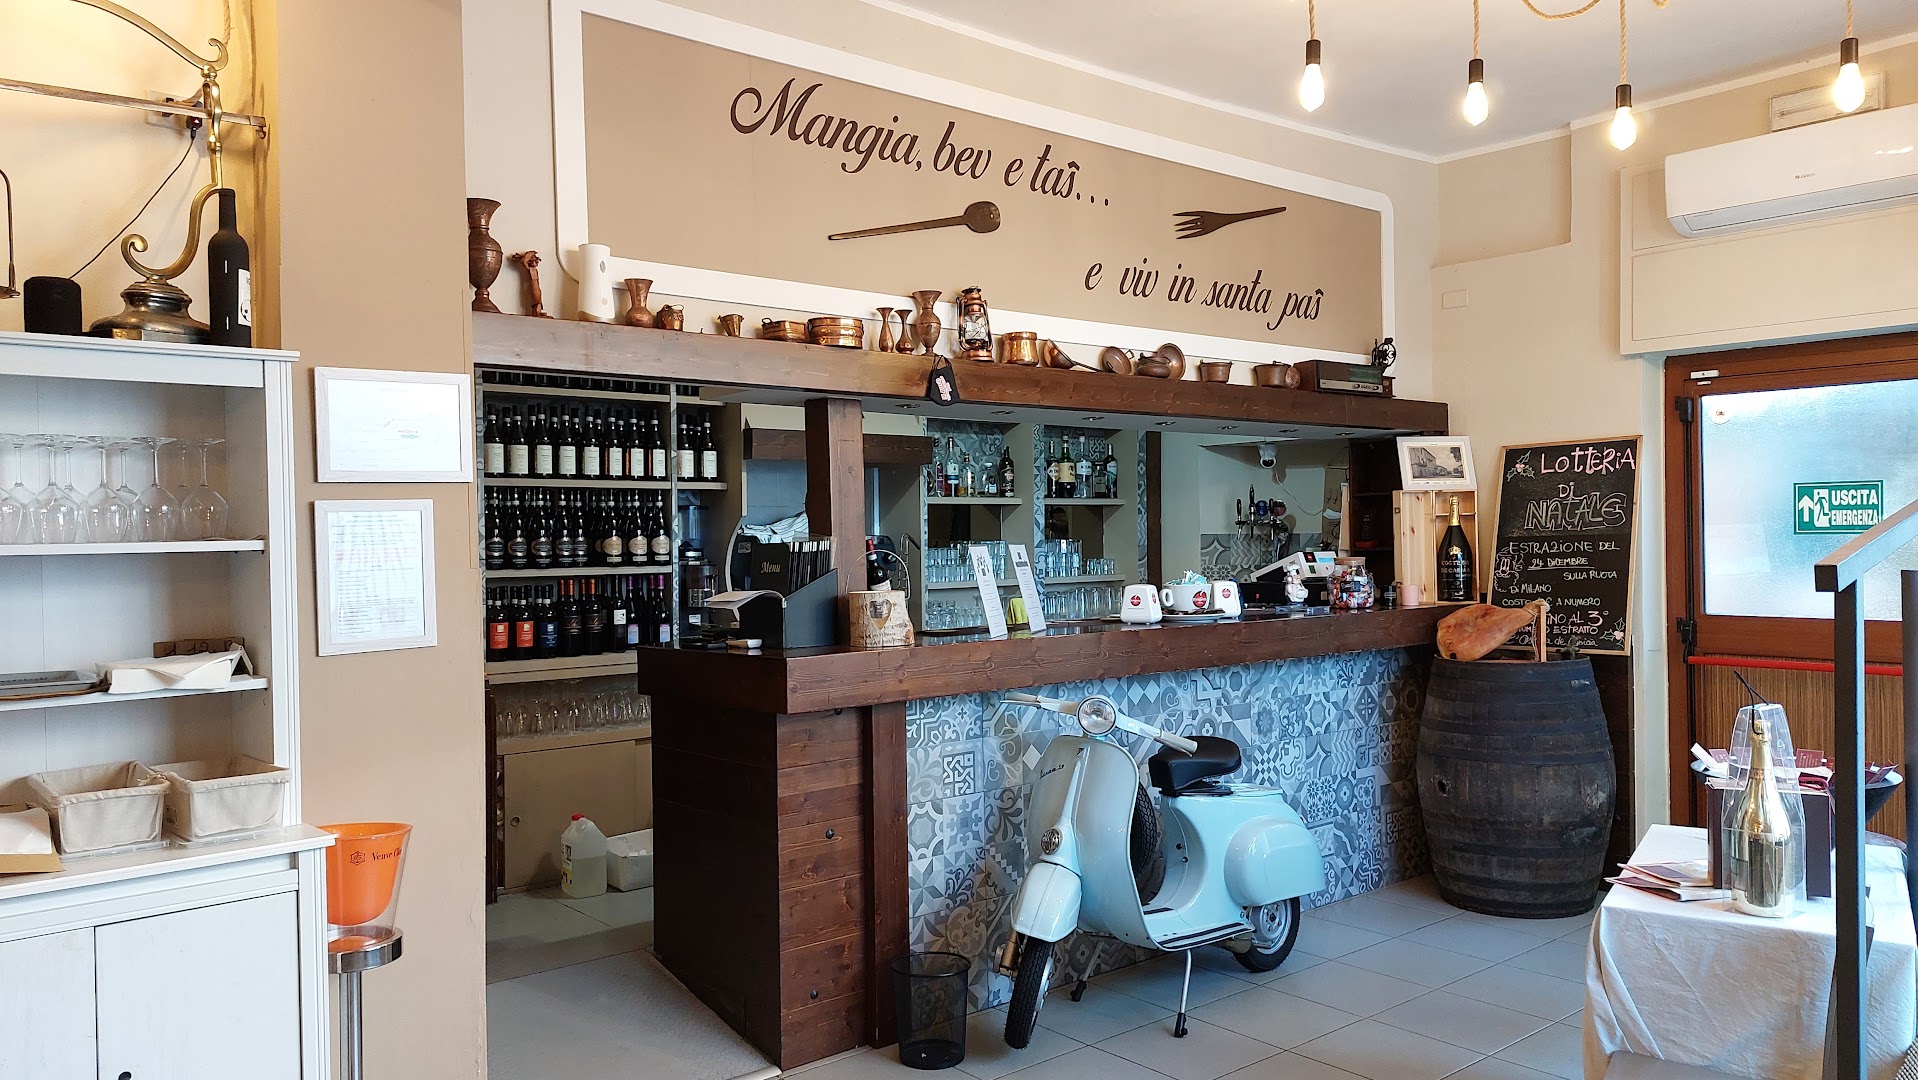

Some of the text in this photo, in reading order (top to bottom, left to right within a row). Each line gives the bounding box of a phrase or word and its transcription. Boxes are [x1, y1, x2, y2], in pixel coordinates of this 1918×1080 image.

[729, 77, 923, 174] Mangia,
[932, 120, 993, 181] bev
[1003, 154, 1024, 188] e
[1083, 261, 1104, 291] e
[1119, 257, 1160, 298] viv
[1166, 262, 1198, 304] in
[1200, 269, 1274, 314] santa
[1831, 488, 1879, 506] USCITA
[1831, 508, 1879, 527] EMERGENZA
[1598, 540, 1620, 551] DEL
[760, 561, 781, 574] Menu
[1531, 558, 1545, 568] 24
[1562, 570, 1618, 581] SULLA RUOTA
[1555, 598, 1563, 607] A
[1563, 597, 1601, 608] NUMERO
[1568, 610, 1584, 625] AL
[1552, 625, 1599, 635] ESTRATTO
[371, 851, 392, 861] Veuve
